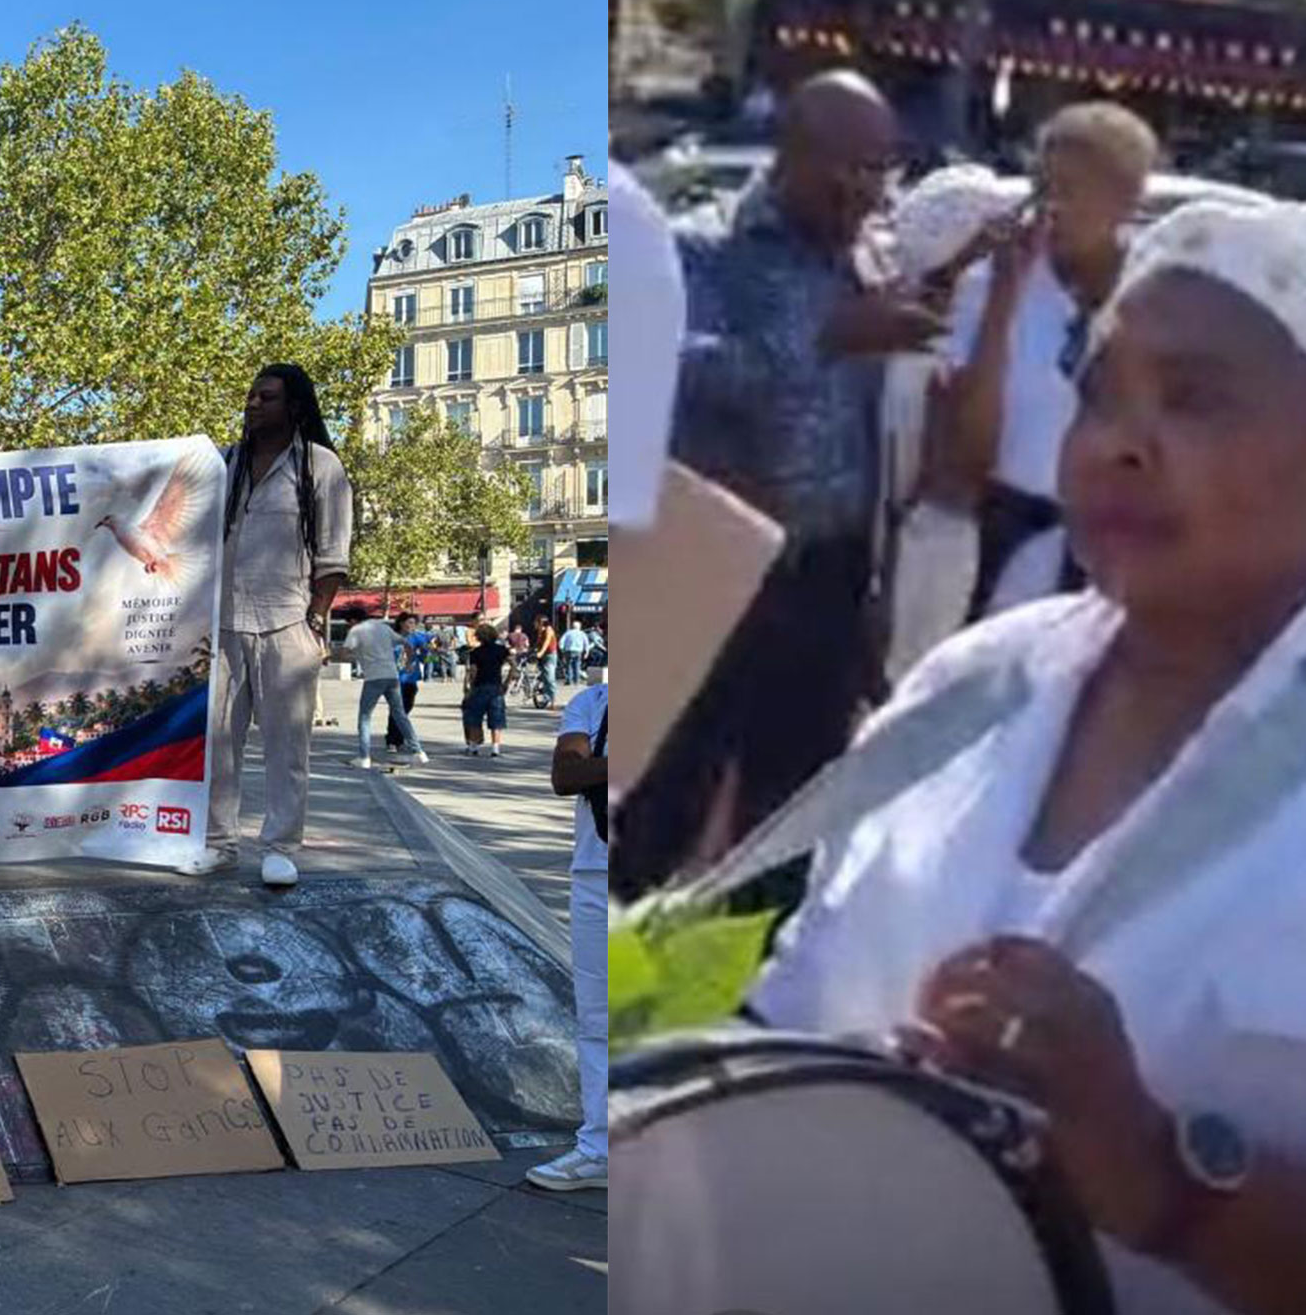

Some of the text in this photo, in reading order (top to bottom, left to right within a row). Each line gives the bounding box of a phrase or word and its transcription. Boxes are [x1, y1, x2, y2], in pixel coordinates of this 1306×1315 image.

[125, 612, 176, 627] JUSTICE
[126, 642, 172, 654] AVENIR
[157, 811, 189, 833] RSI
[78, 1048, 198, 1099] STOP
[285, 1063, 349, 1089] PAS
[298, 1090, 434, 1114] JUSTICE
[57, 1120, 122, 1148] AUX
[312, 1115, 417, 1134] PAS DE
